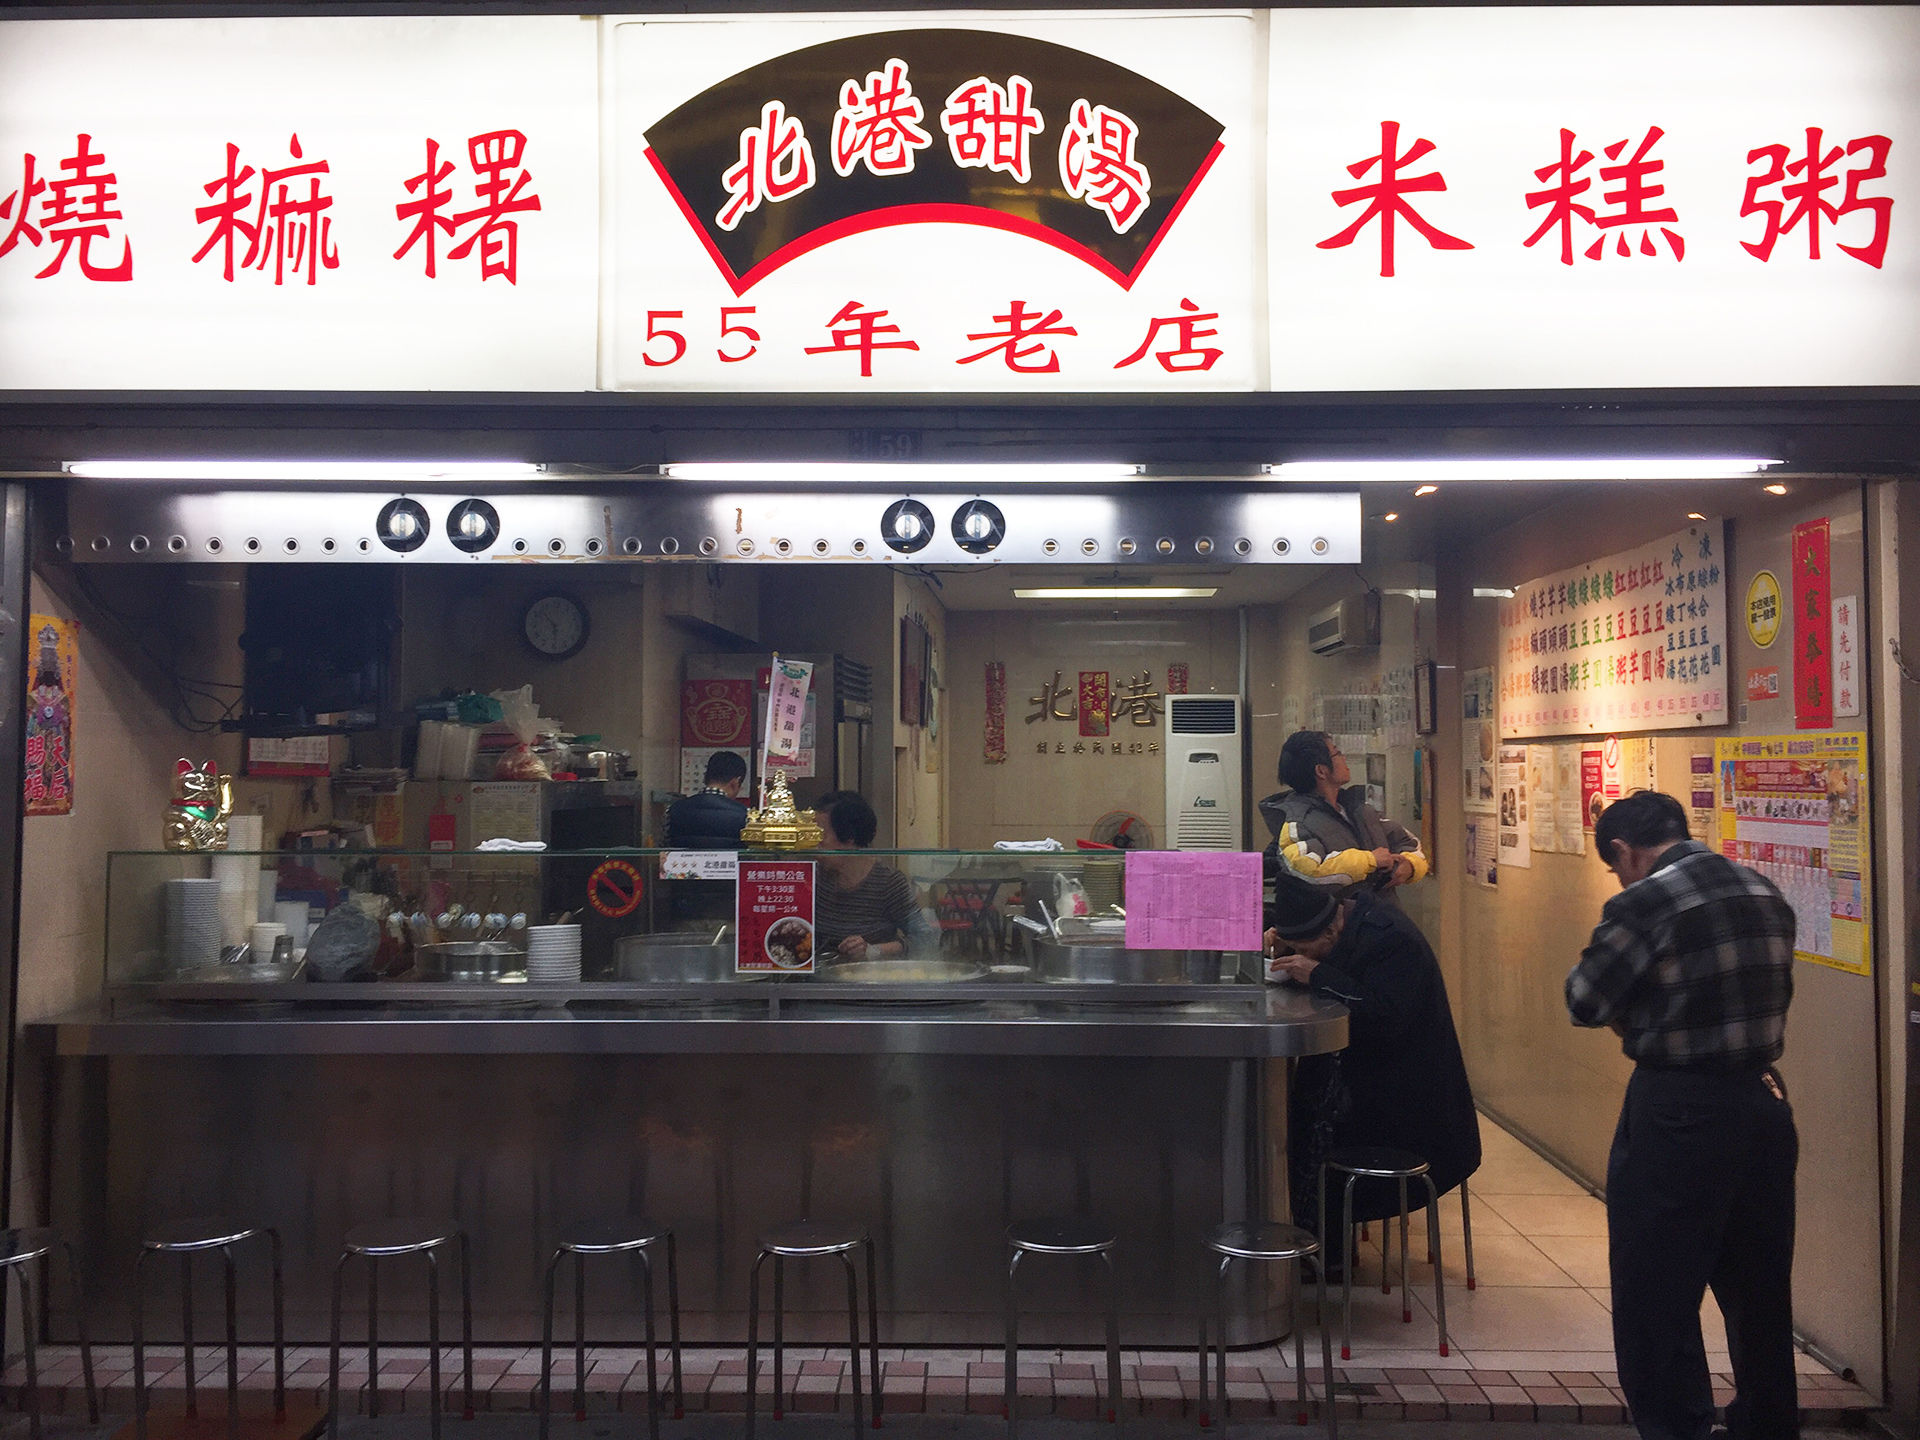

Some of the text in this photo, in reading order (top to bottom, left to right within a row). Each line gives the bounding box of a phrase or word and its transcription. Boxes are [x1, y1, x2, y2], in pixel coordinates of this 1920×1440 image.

[713, 57, 1151, 234] 北港甜湯
[1315, 120, 1894, 278] 米糕粥
[642, 297, 1225, 377] 55年老店
[1025, 670, 1165, 727] 北港
